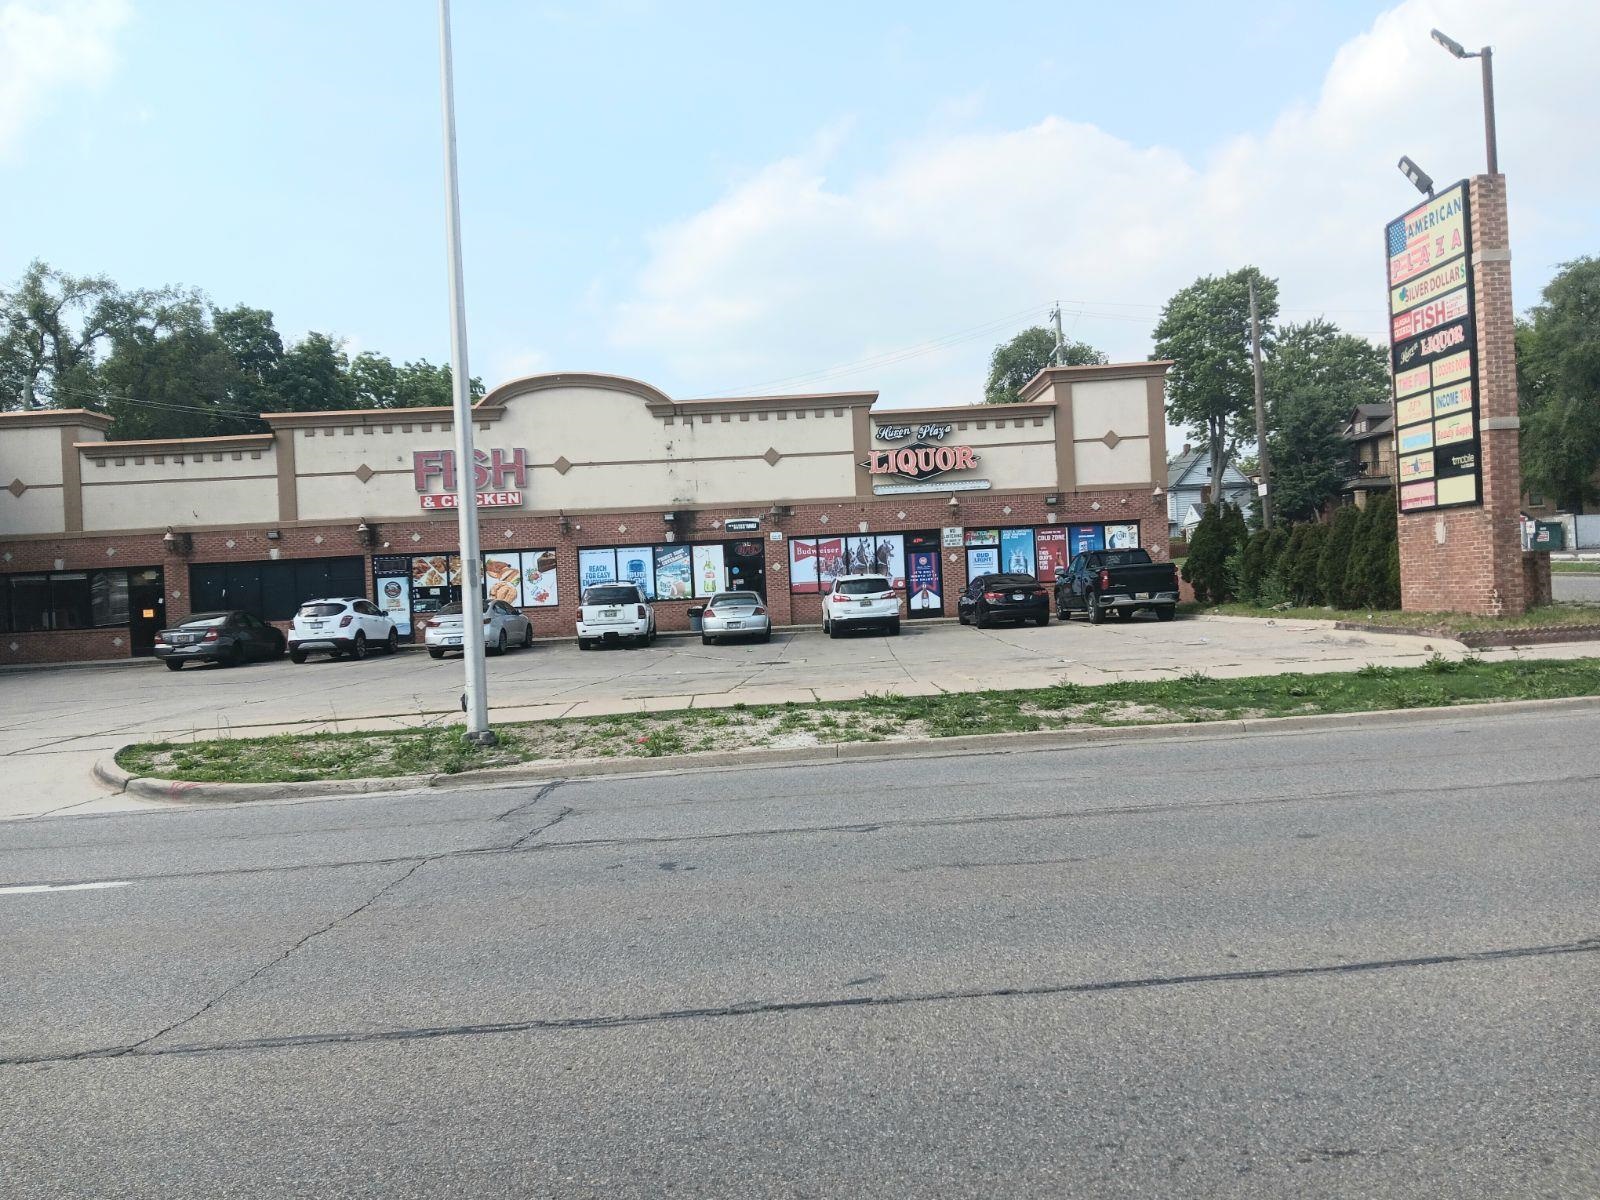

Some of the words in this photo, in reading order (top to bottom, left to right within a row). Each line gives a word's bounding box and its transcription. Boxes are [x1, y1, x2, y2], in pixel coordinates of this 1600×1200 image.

[1406, 197, 1462, 240] AMERICAN
[1392, 228, 1462, 279] PLAZA
[1405, 282, 1429, 303] SILVER
[1412, 300, 1446, 333] FISH
[1421, 325, 1465, 356] LIQUOR
[1436, 391, 1459, 409] INCOME
[876, 426, 911, 440] Huron
[917, 424, 952, 440] Plaza
[868, 446, 978, 476] LIQUOR
[423, 496, 435, 507] &
[441, 493, 520, 507] CHCKEN
[797, 546, 839, 555] Budweiser
